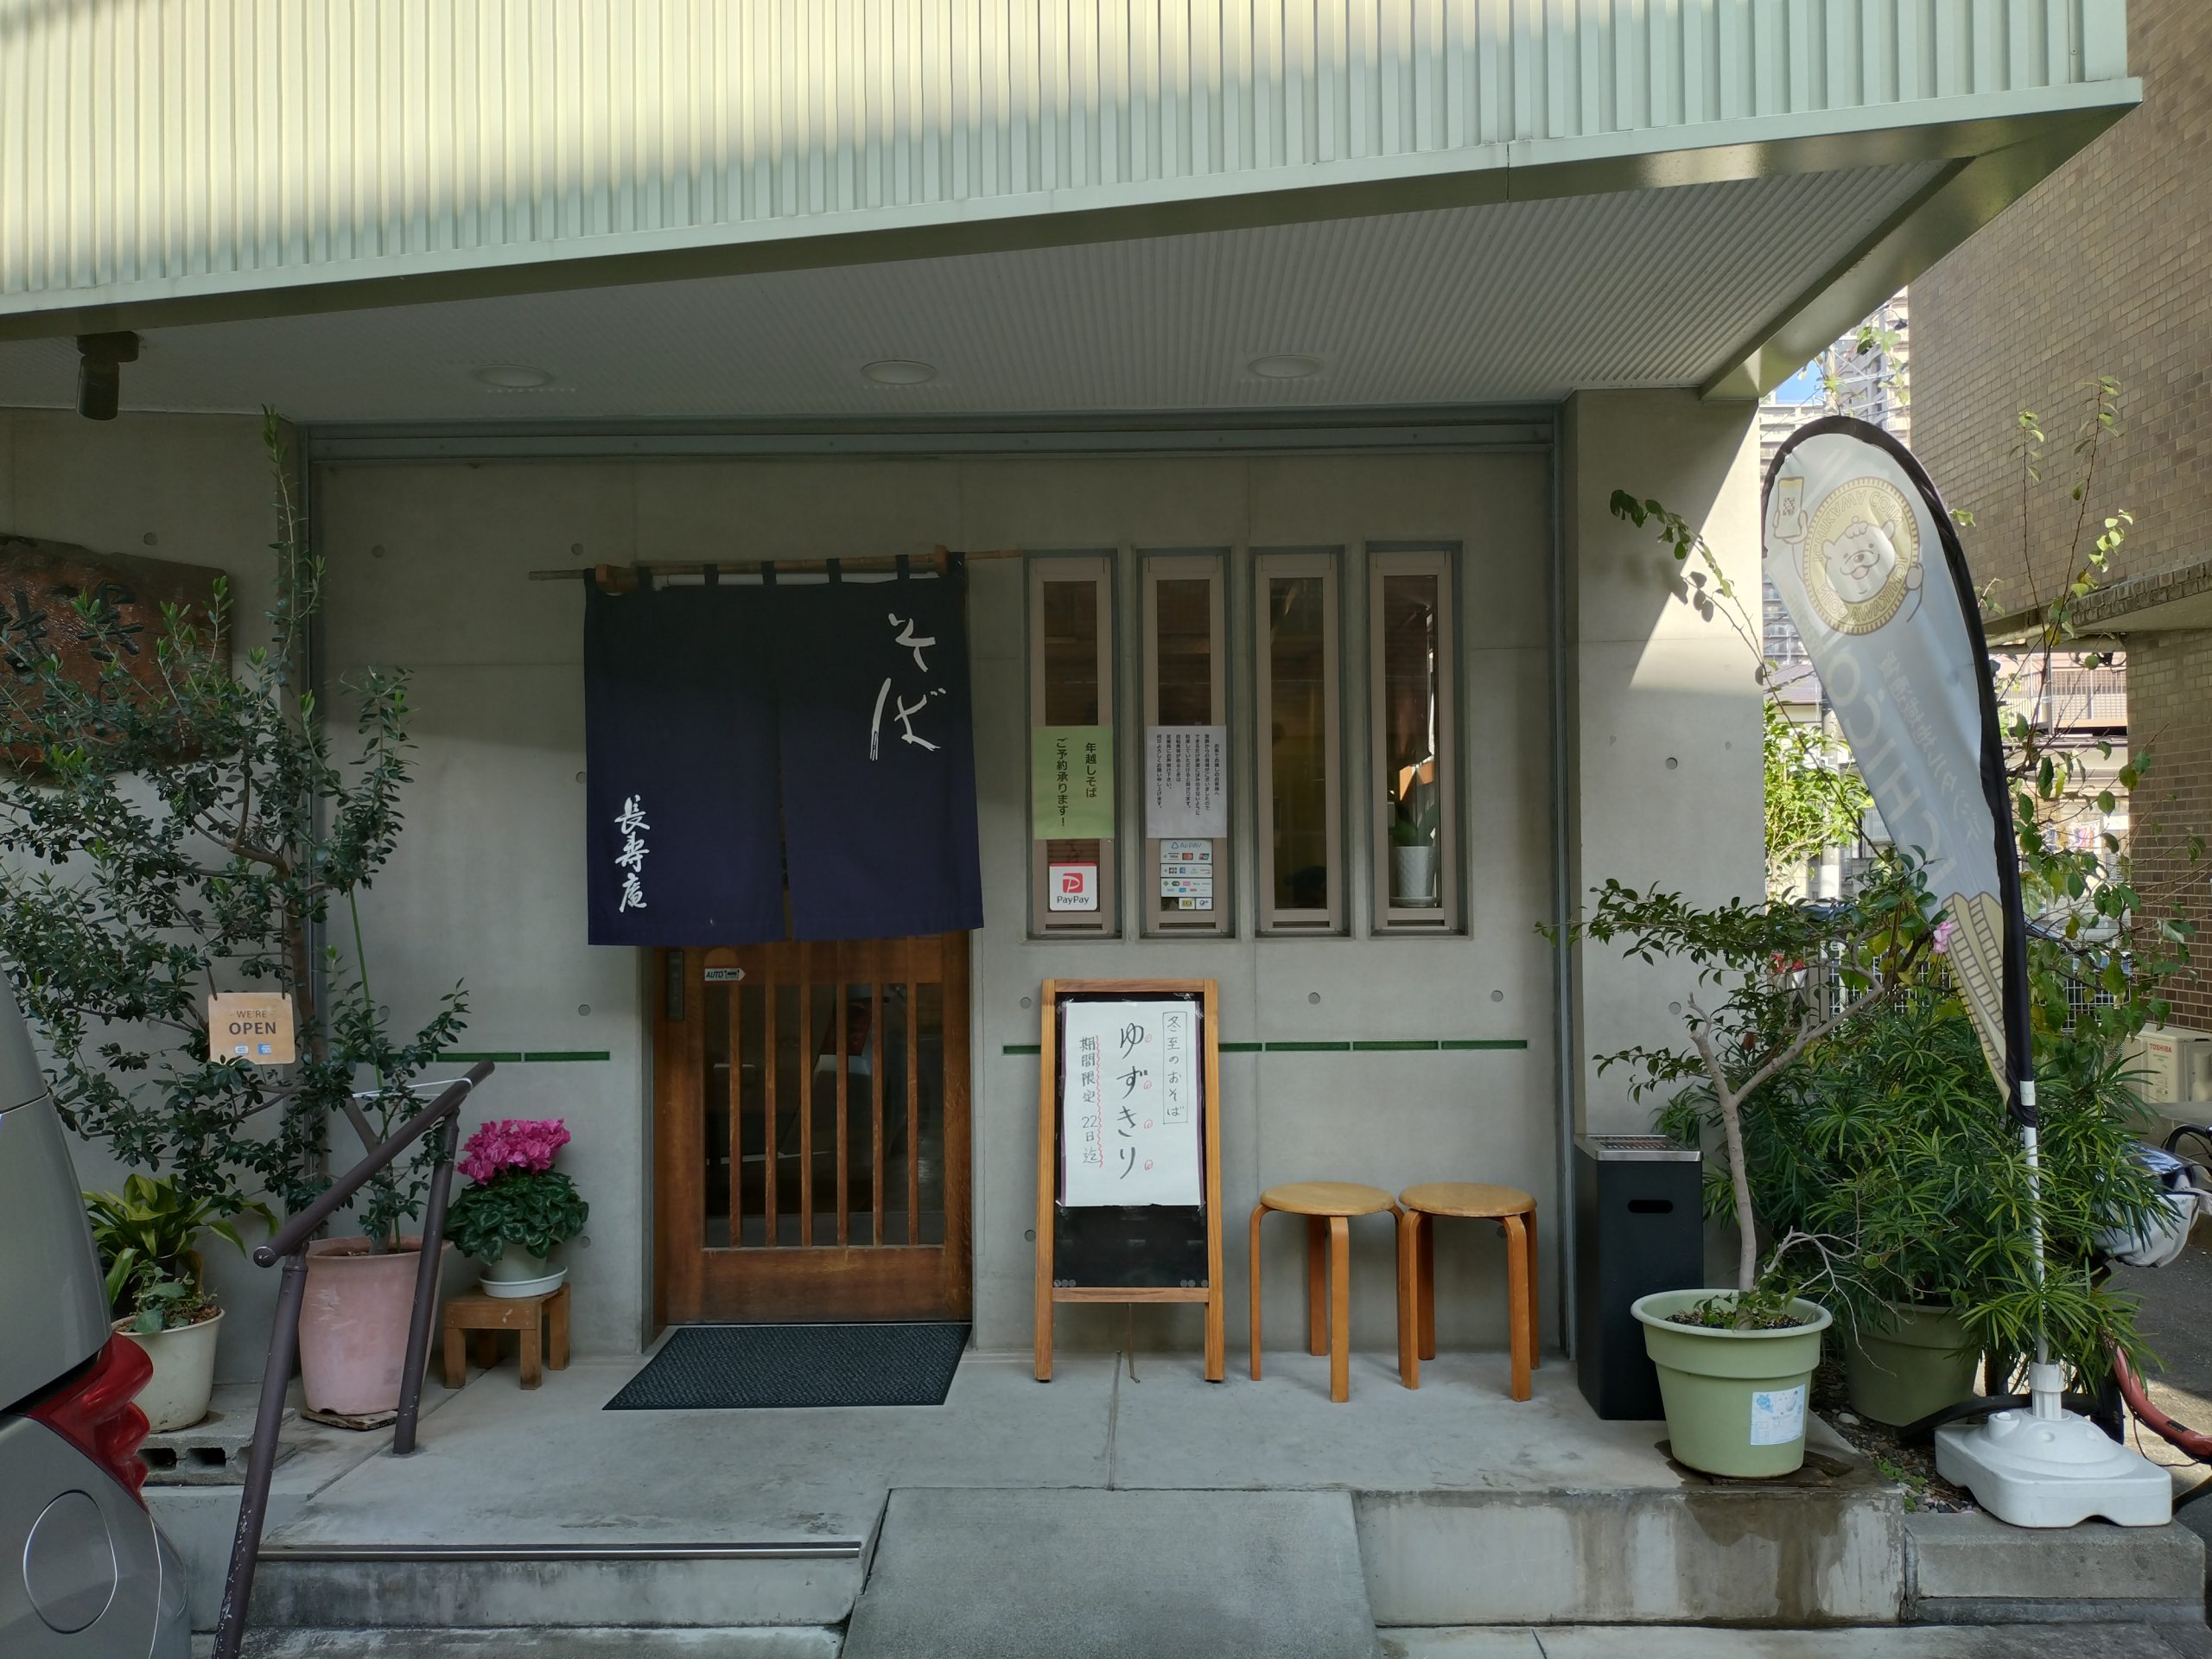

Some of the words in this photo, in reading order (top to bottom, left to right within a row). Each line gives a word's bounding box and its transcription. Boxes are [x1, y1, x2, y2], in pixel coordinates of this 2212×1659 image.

[869, 613, 947, 761] そば
[1085, 742, 1097, 798] 年越しそば
[614, 794, 651, 913] 長寿庵
[1057, 895, 1090, 905] PayPay
[228, 1021, 276, 1035] OPEN
[236, 1010, 268, 1019] WE'RE
[1166, 1015, 1185, 1117] 冬至のおそば
[2149, 1043, 2172, 1052] TOSHIBA
[1116, 1022, 1147, 1180] ゆずきり
